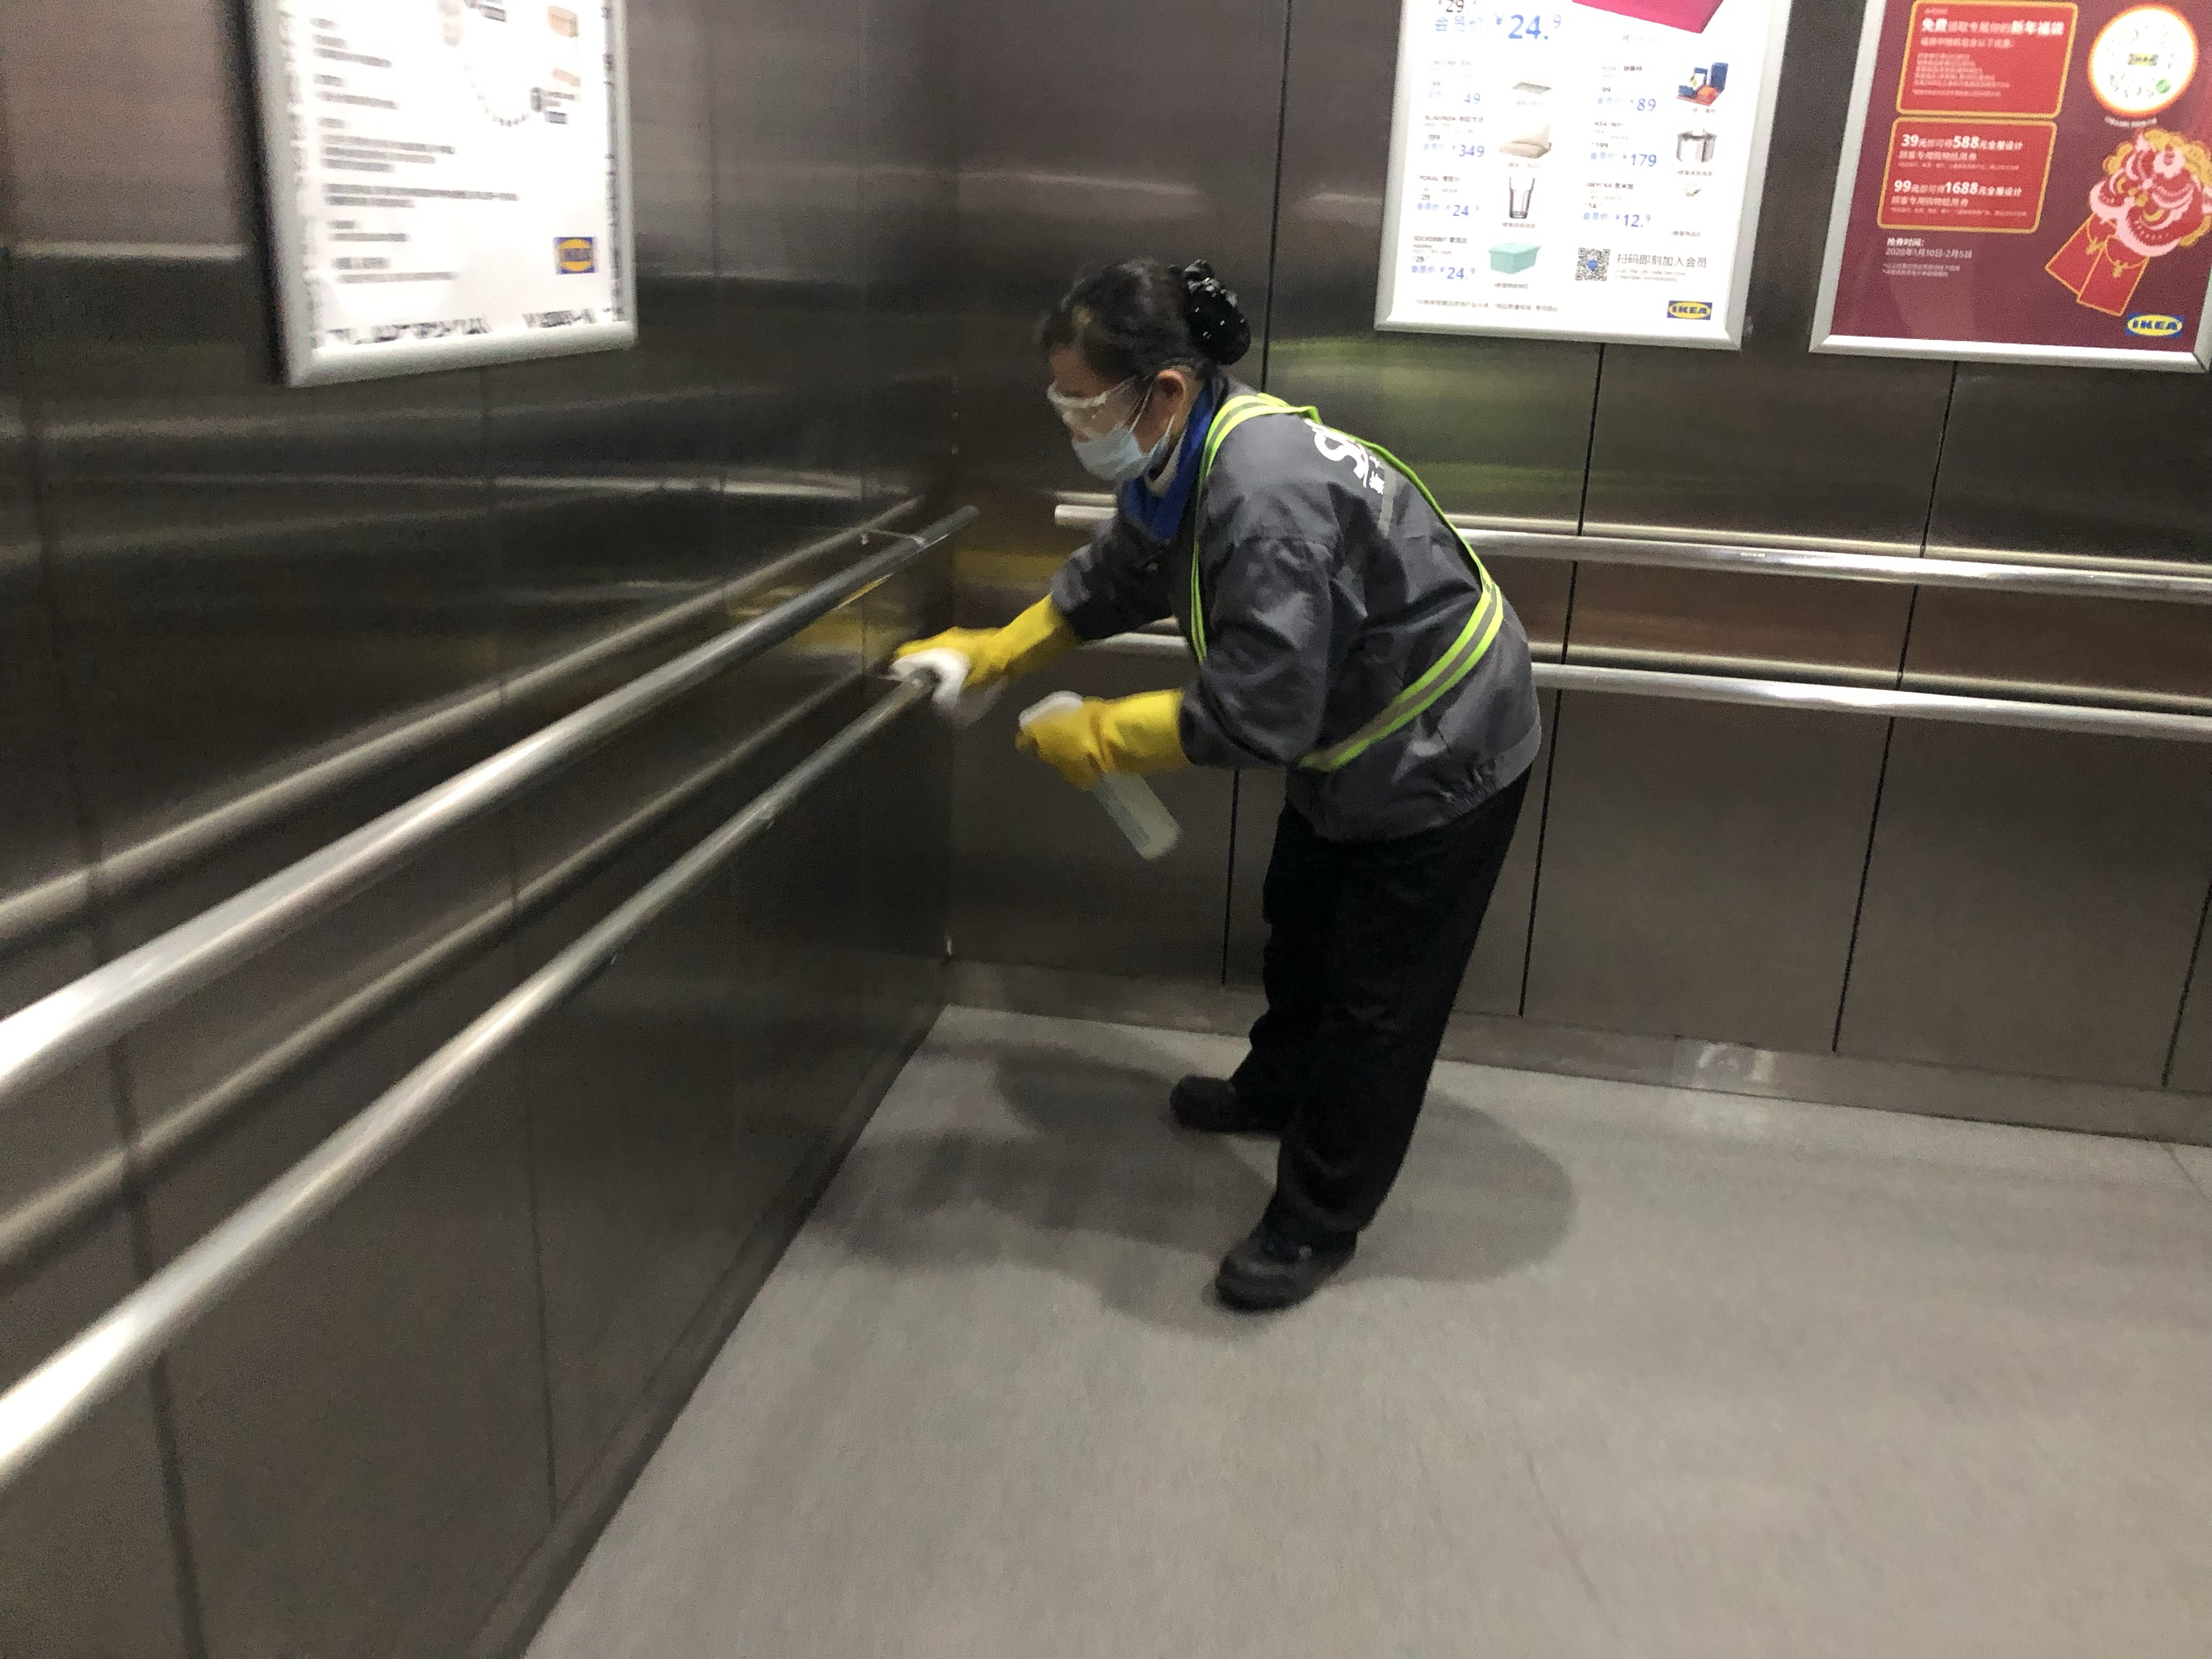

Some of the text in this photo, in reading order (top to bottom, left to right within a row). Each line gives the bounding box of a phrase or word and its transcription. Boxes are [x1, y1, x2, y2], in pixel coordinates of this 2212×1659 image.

[1617, 252, 1708, 269] 扫码即刻加入会员
[2132, 319, 2178, 330] IKEA
